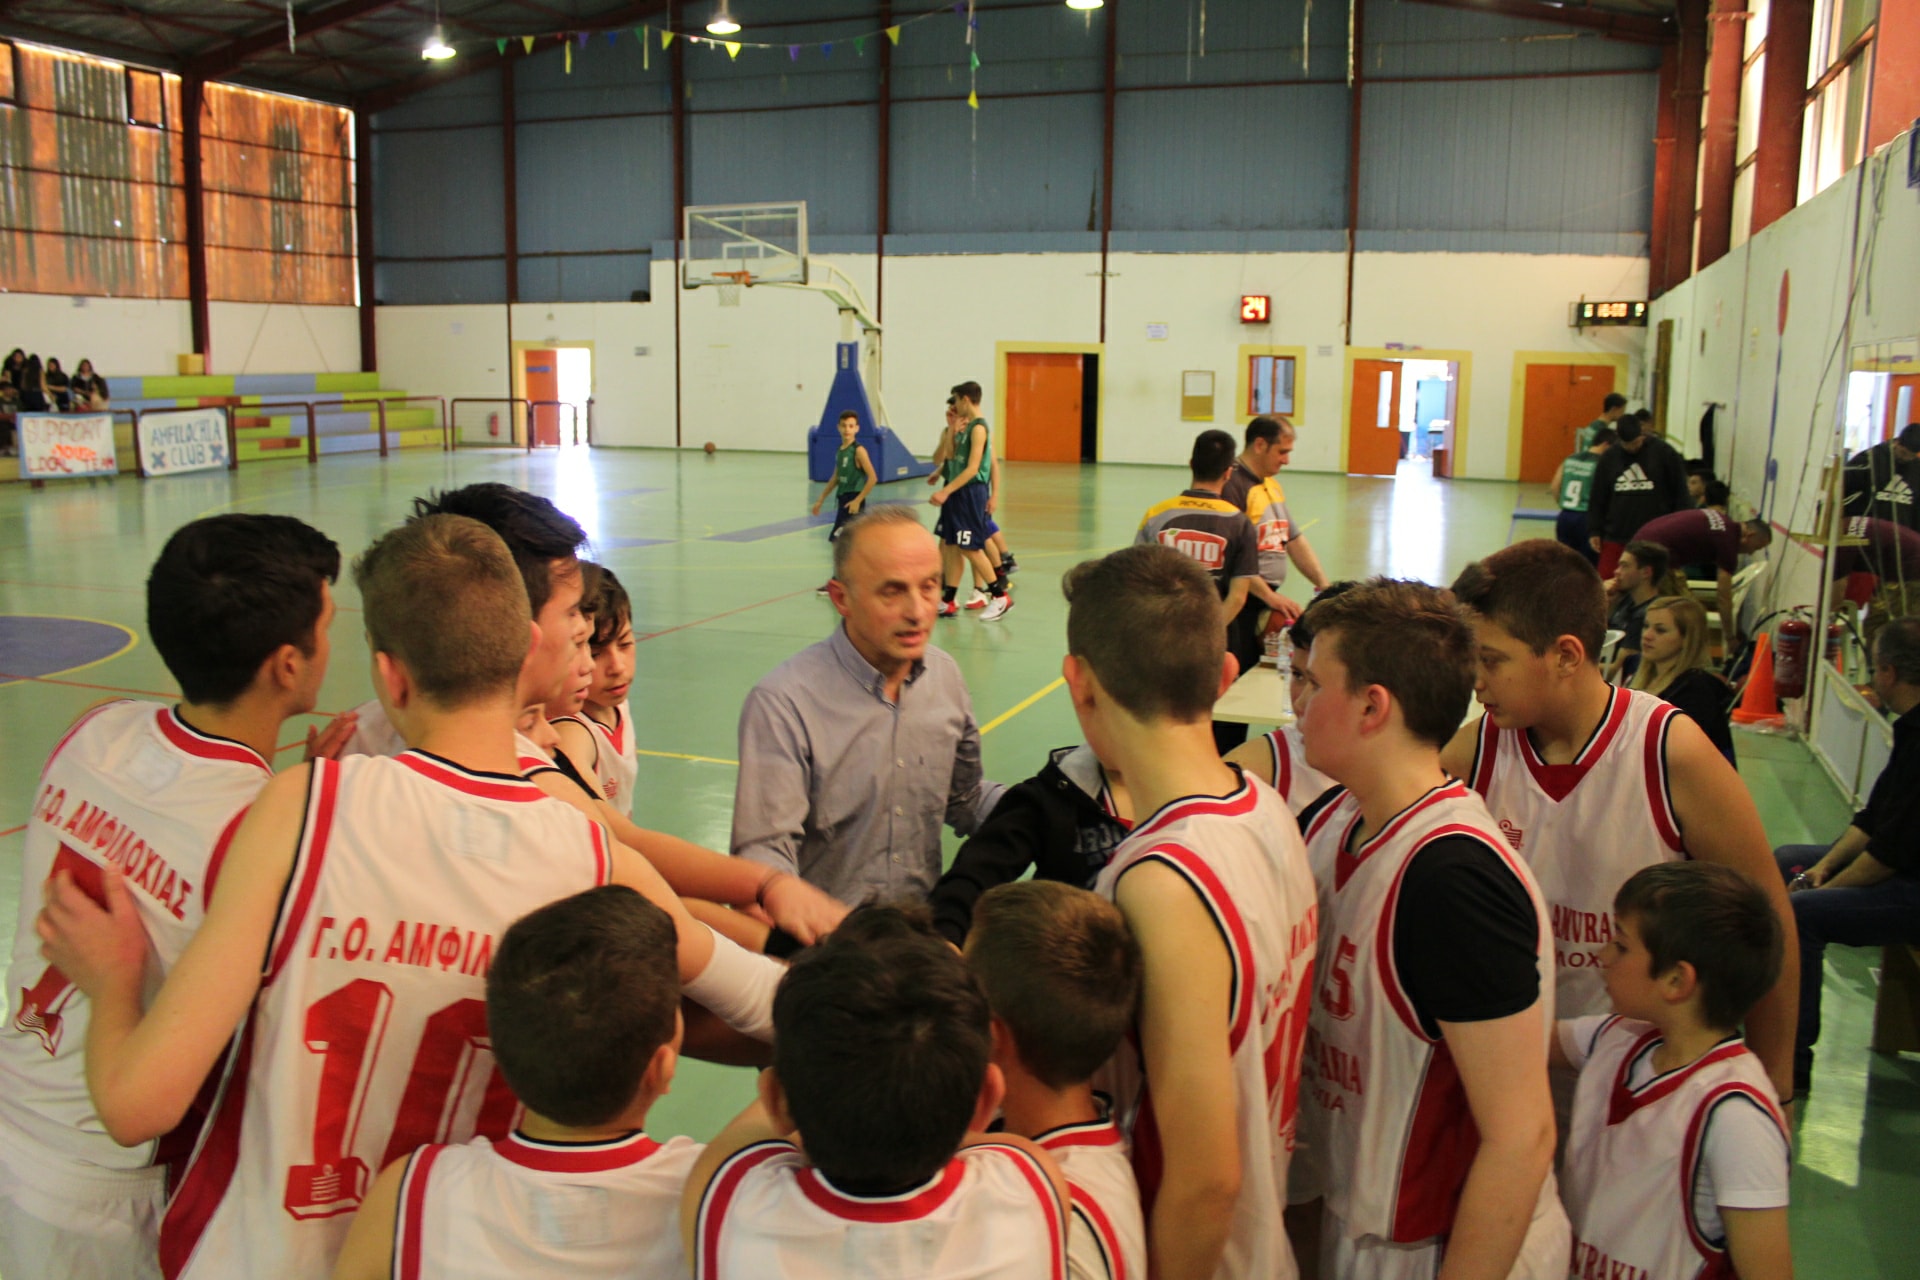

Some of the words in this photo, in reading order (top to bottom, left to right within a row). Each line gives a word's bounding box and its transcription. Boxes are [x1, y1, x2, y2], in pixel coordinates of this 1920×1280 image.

[1243, 296, 1266, 319] 24
[170, 444, 205, 466] CLUB
[1562, 480, 1582, 508] 9
[1614, 480, 1655, 492] adidas
[956, 530, 972, 545] 15
